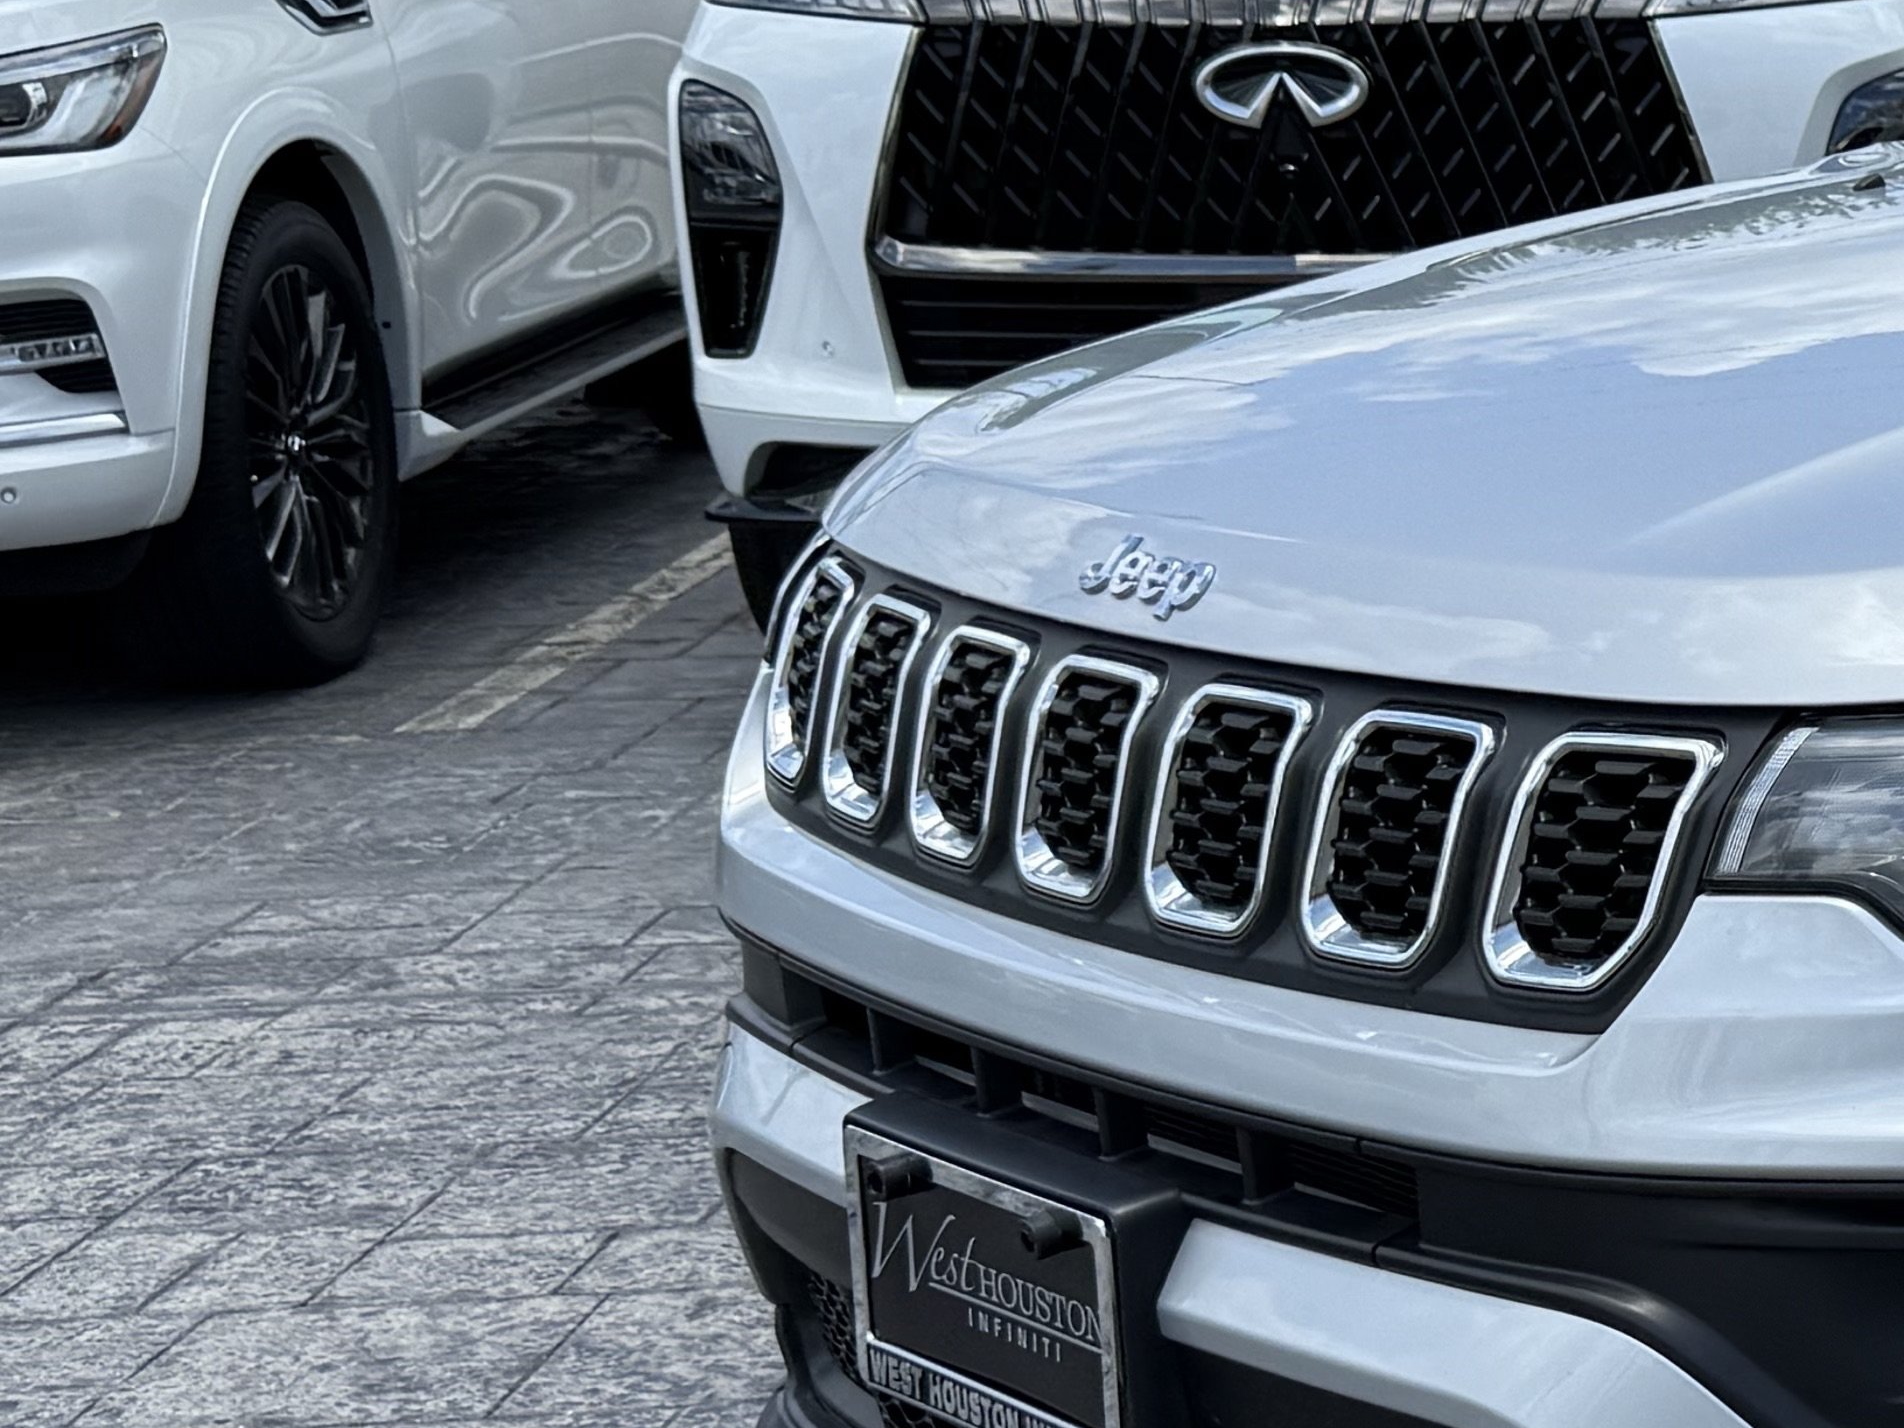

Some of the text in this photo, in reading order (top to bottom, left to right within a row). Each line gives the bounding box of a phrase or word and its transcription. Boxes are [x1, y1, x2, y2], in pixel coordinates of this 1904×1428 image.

[1078, 532, 1218, 622] Jeep
[967, 1306, 1064, 1364] INFINITI
[868, 1347, 923, 1400] WEST
